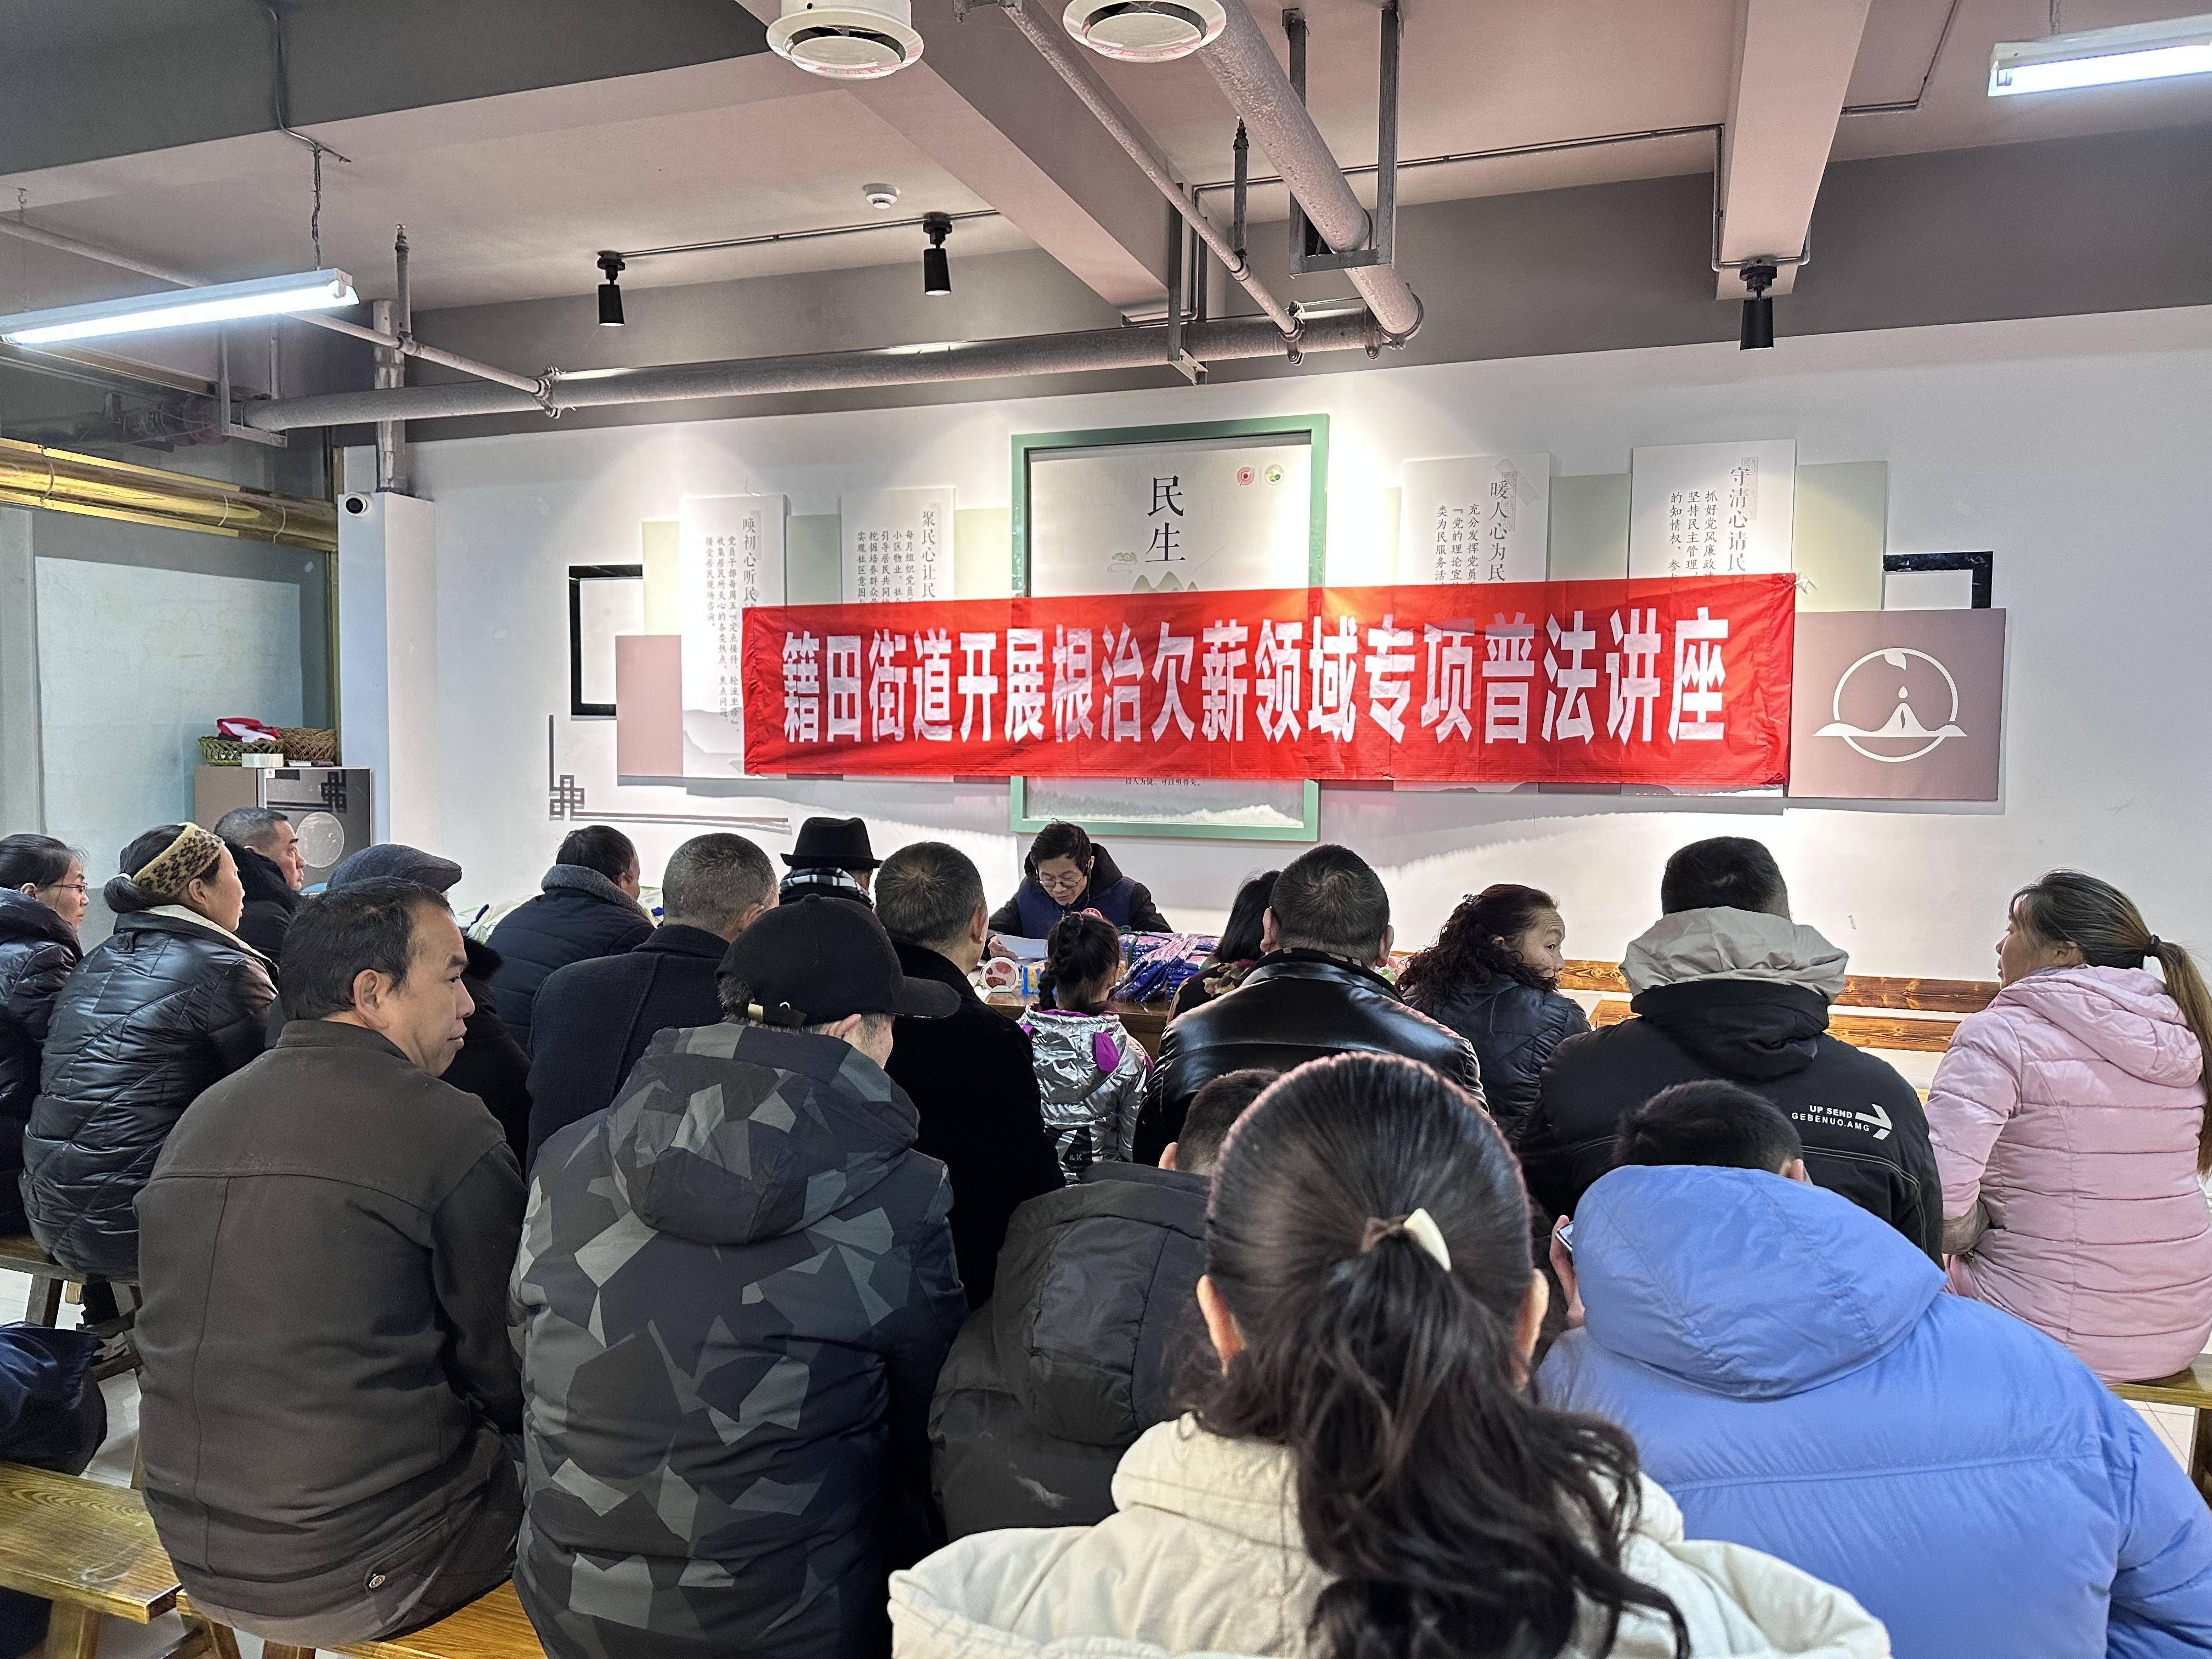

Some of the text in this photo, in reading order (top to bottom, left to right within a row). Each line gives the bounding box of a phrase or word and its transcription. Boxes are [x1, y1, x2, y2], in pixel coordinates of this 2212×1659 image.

[742, 517, 757, 607] 唤初心听民
[922, 511, 935, 601] 聚民心让民
[1146, 475, 1186, 562] 民生
[1435, 505, 1448, 585] 类为民服务活
[1450, 509, 1464, 585] 『党的理论宣
[1466, 503, 1480, 584] 充分发挥党员
[1488, 480, 1509, 582] 暖人心为民
[1728, 466, 1750, 576] 守清心请民
[782, 607, 1729, 745] 籍田街道开展根治欠薪领域专项普法讲座
[1791, 1112, 1870, 1132] GEBENUO.AMG
[1809, 1105, 1853, 1119] UP SEND
